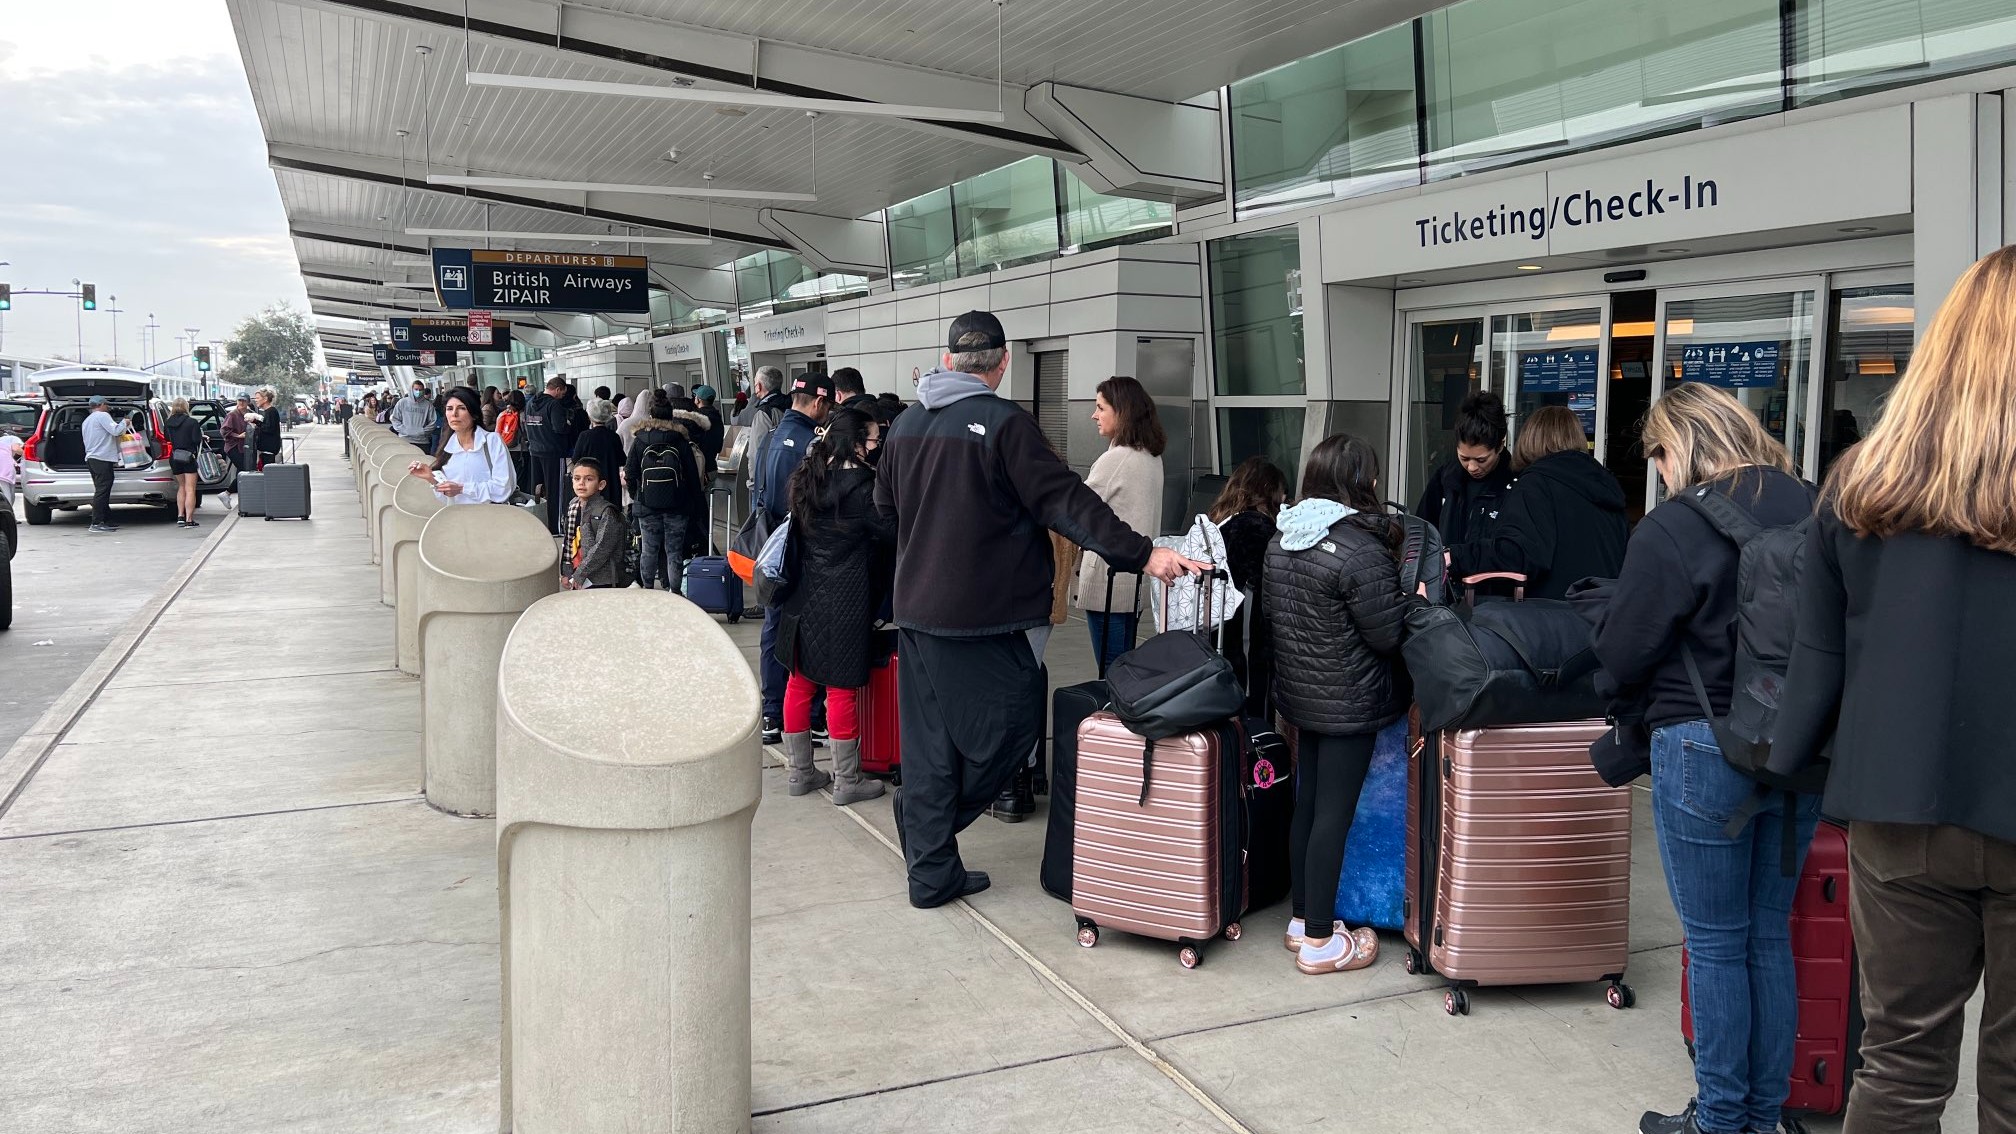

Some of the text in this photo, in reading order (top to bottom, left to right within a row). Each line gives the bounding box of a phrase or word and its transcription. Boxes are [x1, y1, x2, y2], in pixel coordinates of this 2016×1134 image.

[1416, 175, 1718, 248] Ticketing/Check-In
[505, 253, 597, 266] DEPARTURES
[492, 270, 632, 293] British Airways
[492, 288, 551, 304] ZIPAIR
[422, 333, 468, 342] Southwe
